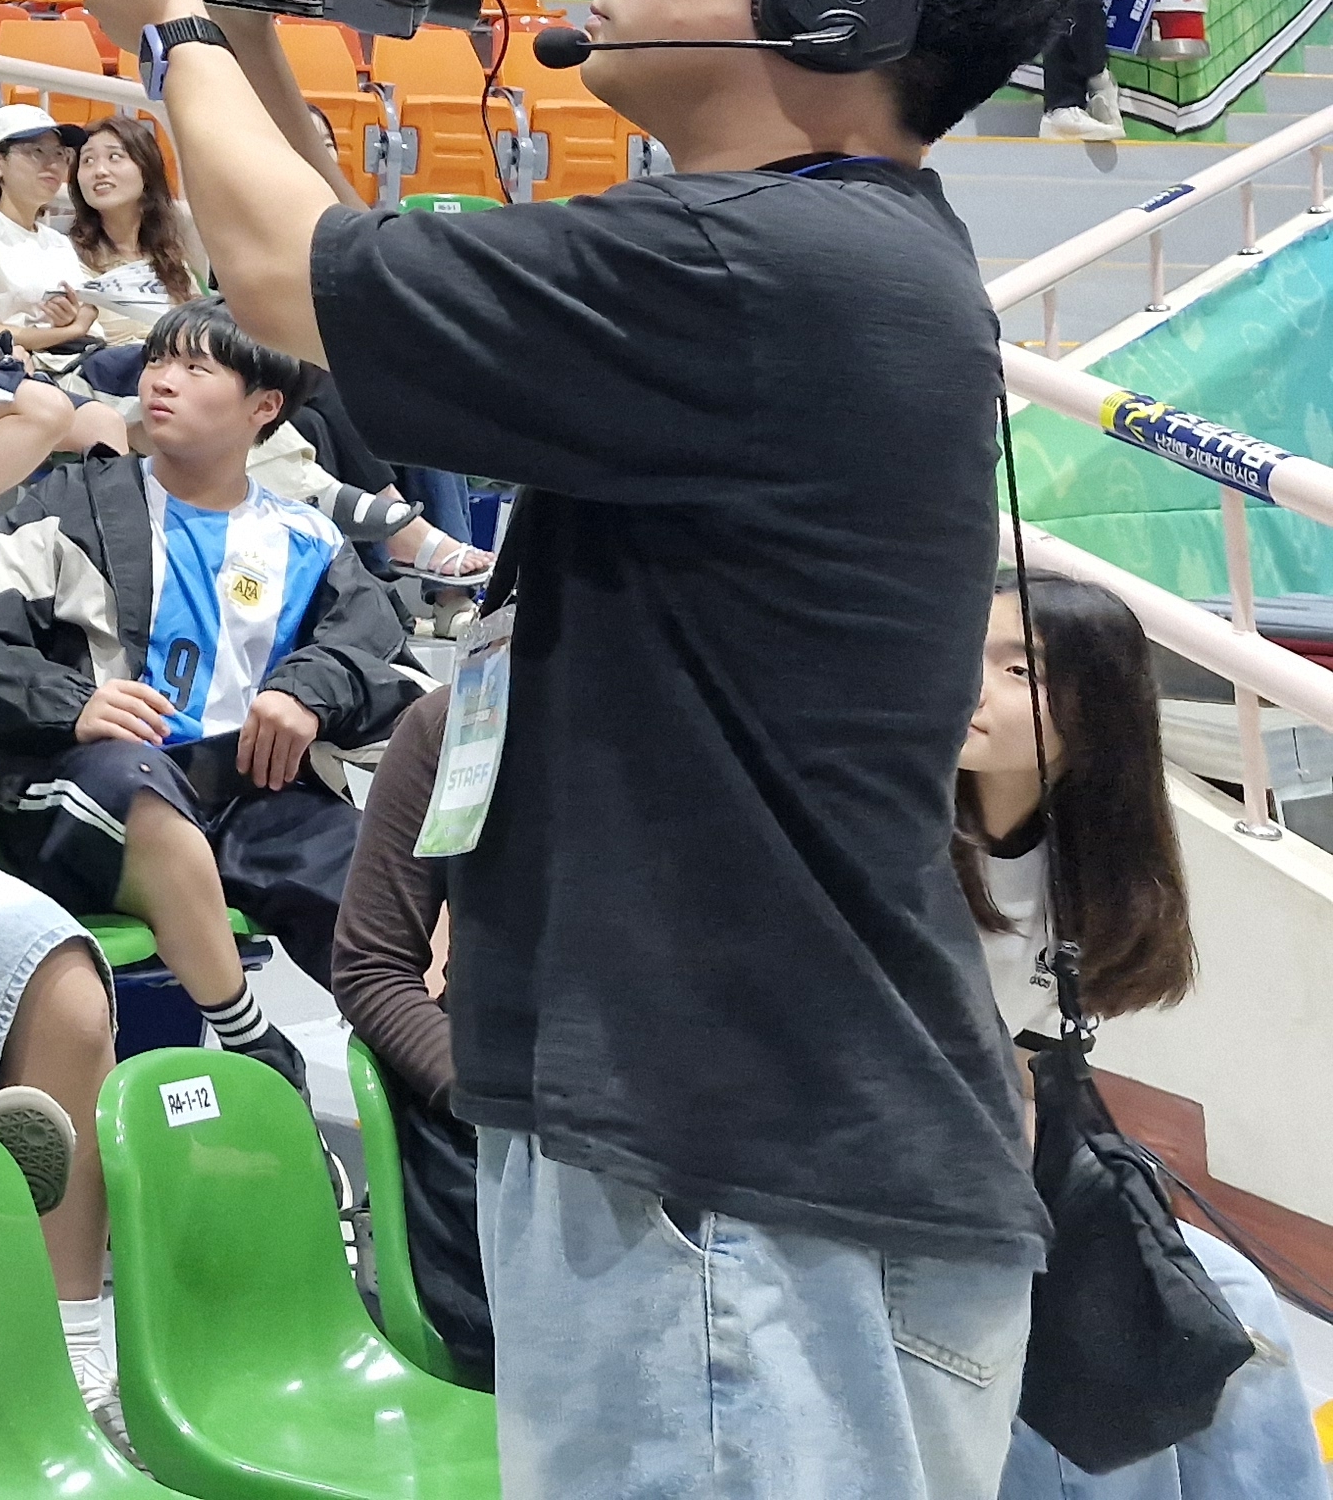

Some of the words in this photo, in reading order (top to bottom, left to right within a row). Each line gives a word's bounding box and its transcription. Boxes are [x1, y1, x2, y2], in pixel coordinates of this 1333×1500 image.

[1189, 449, 1225, 476] 기대지
[1224, 461, 1262, 489] 마시오
[159, 637, 201, 712] 9
[446, 761, 491, 791] STAFF
[167, 1086, 212, 1116] R4-1-12
